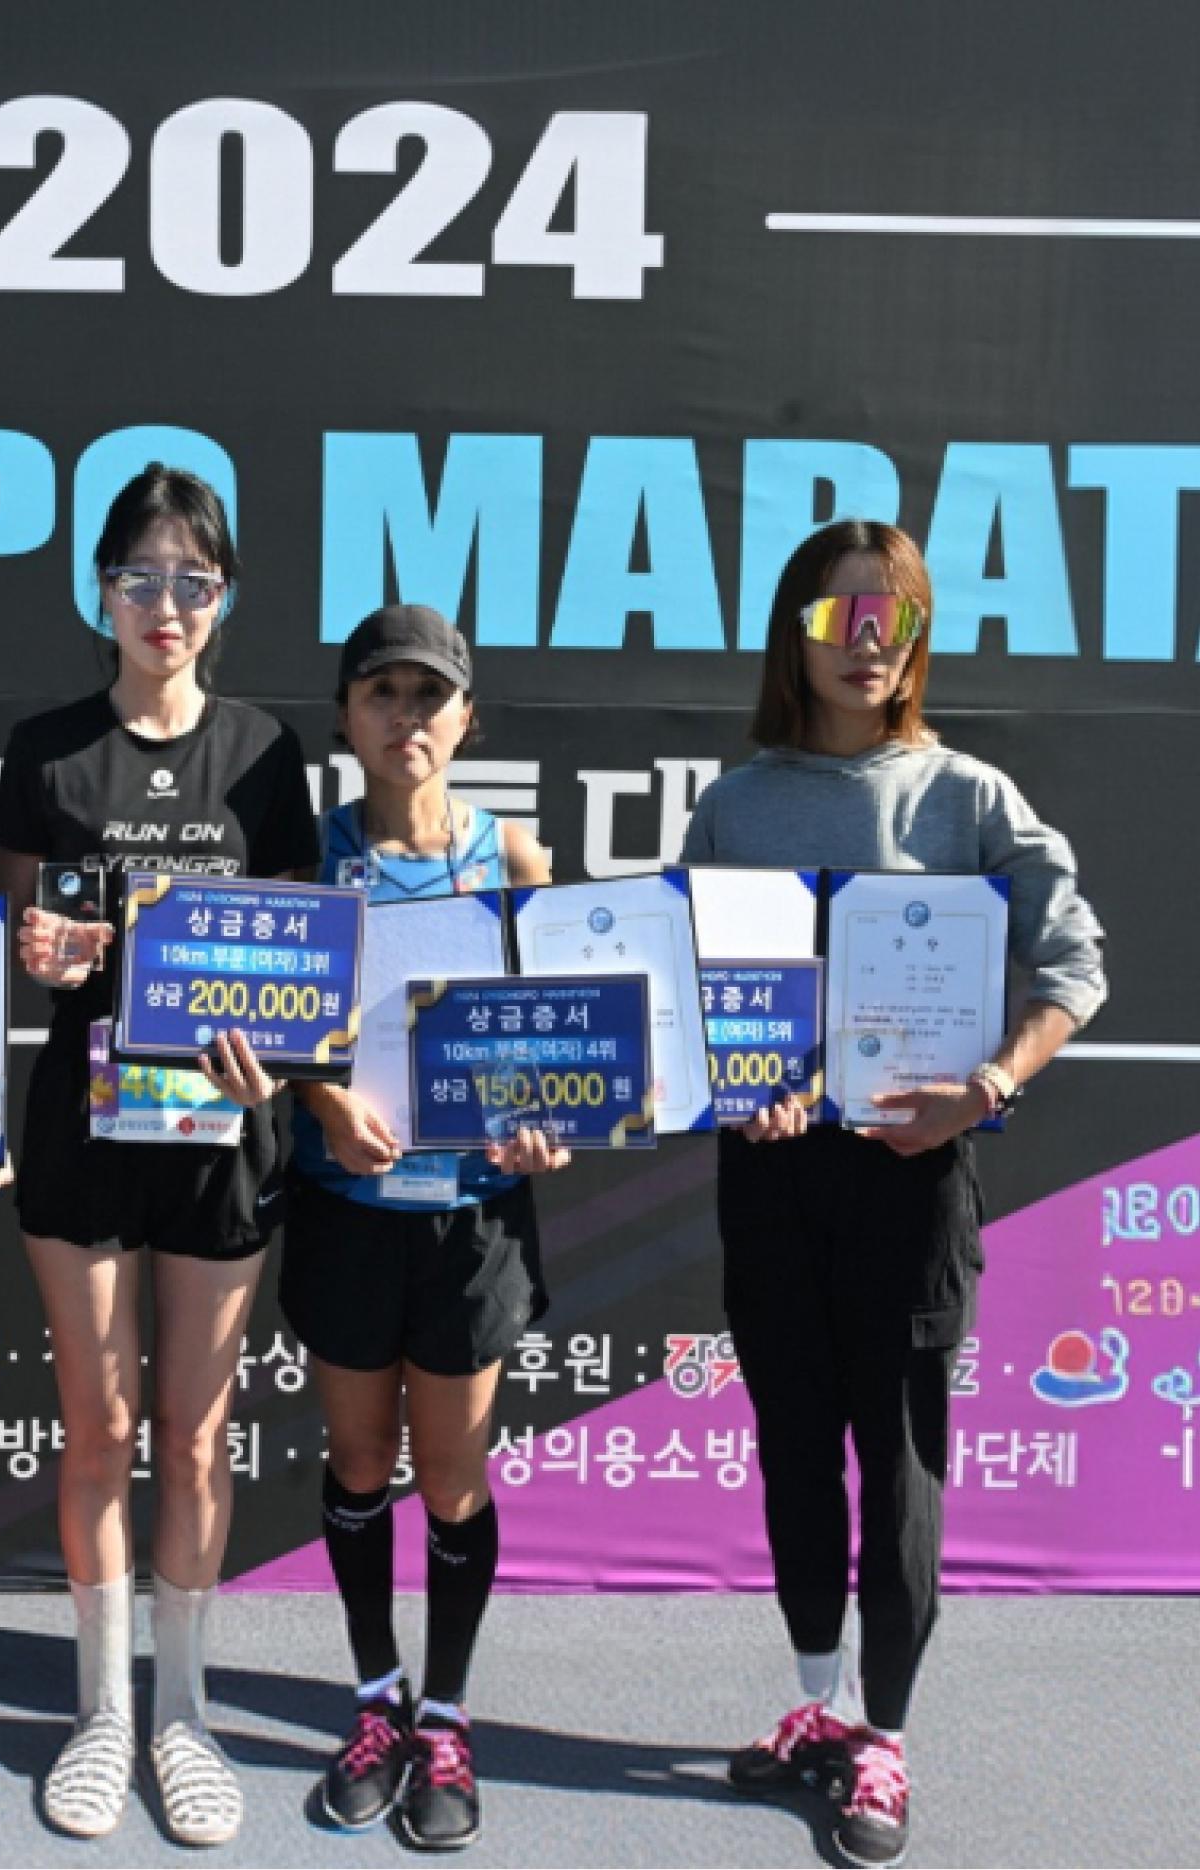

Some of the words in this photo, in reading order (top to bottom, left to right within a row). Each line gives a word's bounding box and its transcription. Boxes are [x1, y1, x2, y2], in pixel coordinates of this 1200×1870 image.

[320, 432, 1200, 660] MARAT
[102, 821, 170, 842] RUN
[179, 823, 225, 842] ON
[160, 944, 208, 963] 10km
[302, 951, 330, 975] 3위
[144, 982, 183, 1007] 상금
[443, 1041, 489, 1061] 10km
[587, 1038, 617, 1061] 4위
[431, 1078, 468, 1103] 상금
[506, 1330, 611, 1394] 후원
